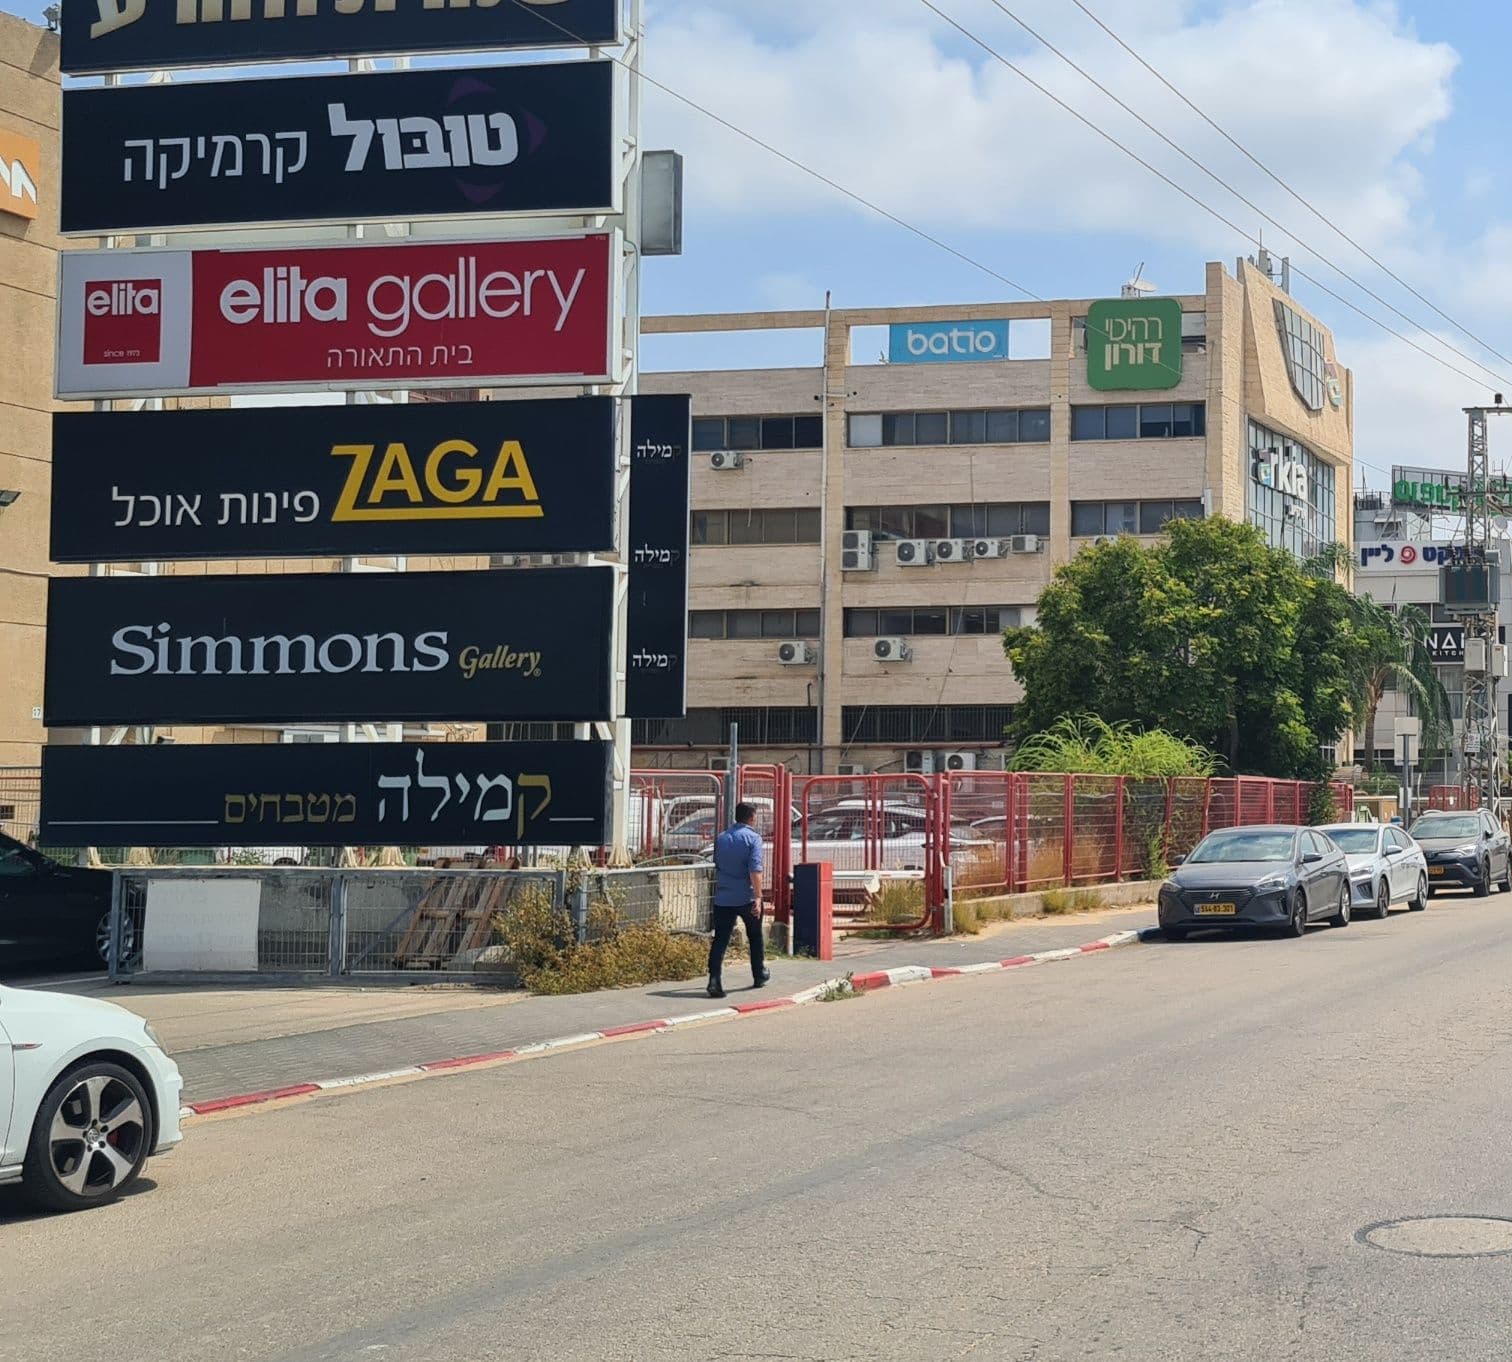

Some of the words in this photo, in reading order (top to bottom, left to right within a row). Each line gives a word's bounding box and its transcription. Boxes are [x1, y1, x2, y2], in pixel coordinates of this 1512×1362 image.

[328, 102, 518, 172] טובול
[122, 131, 308, 190] קרמיקה
[86, 282, 159, 316] elita
[219, 266, 347, 324] elita
[366, 257, 586, 337] gallery
[906, 327, 996, 356] batio
[1104, 316, 1163, 342] רהיטי
[326, 345, 422, 369] התאורה
[431, 343, 473, 367] בית
[1104, 343, 1163, 371] דורון
[329, 439, 545, 522] ZAGA
[112, 487, 202, 527] אוכל
[218, 489, 320, 525] פינות
[1361, 543, 1394, 567] ליין
[110, 622, 450, 676] Simmons
[224, 792, 357, 824] מטבחים
[378, 748, 553, 840] קמילה
